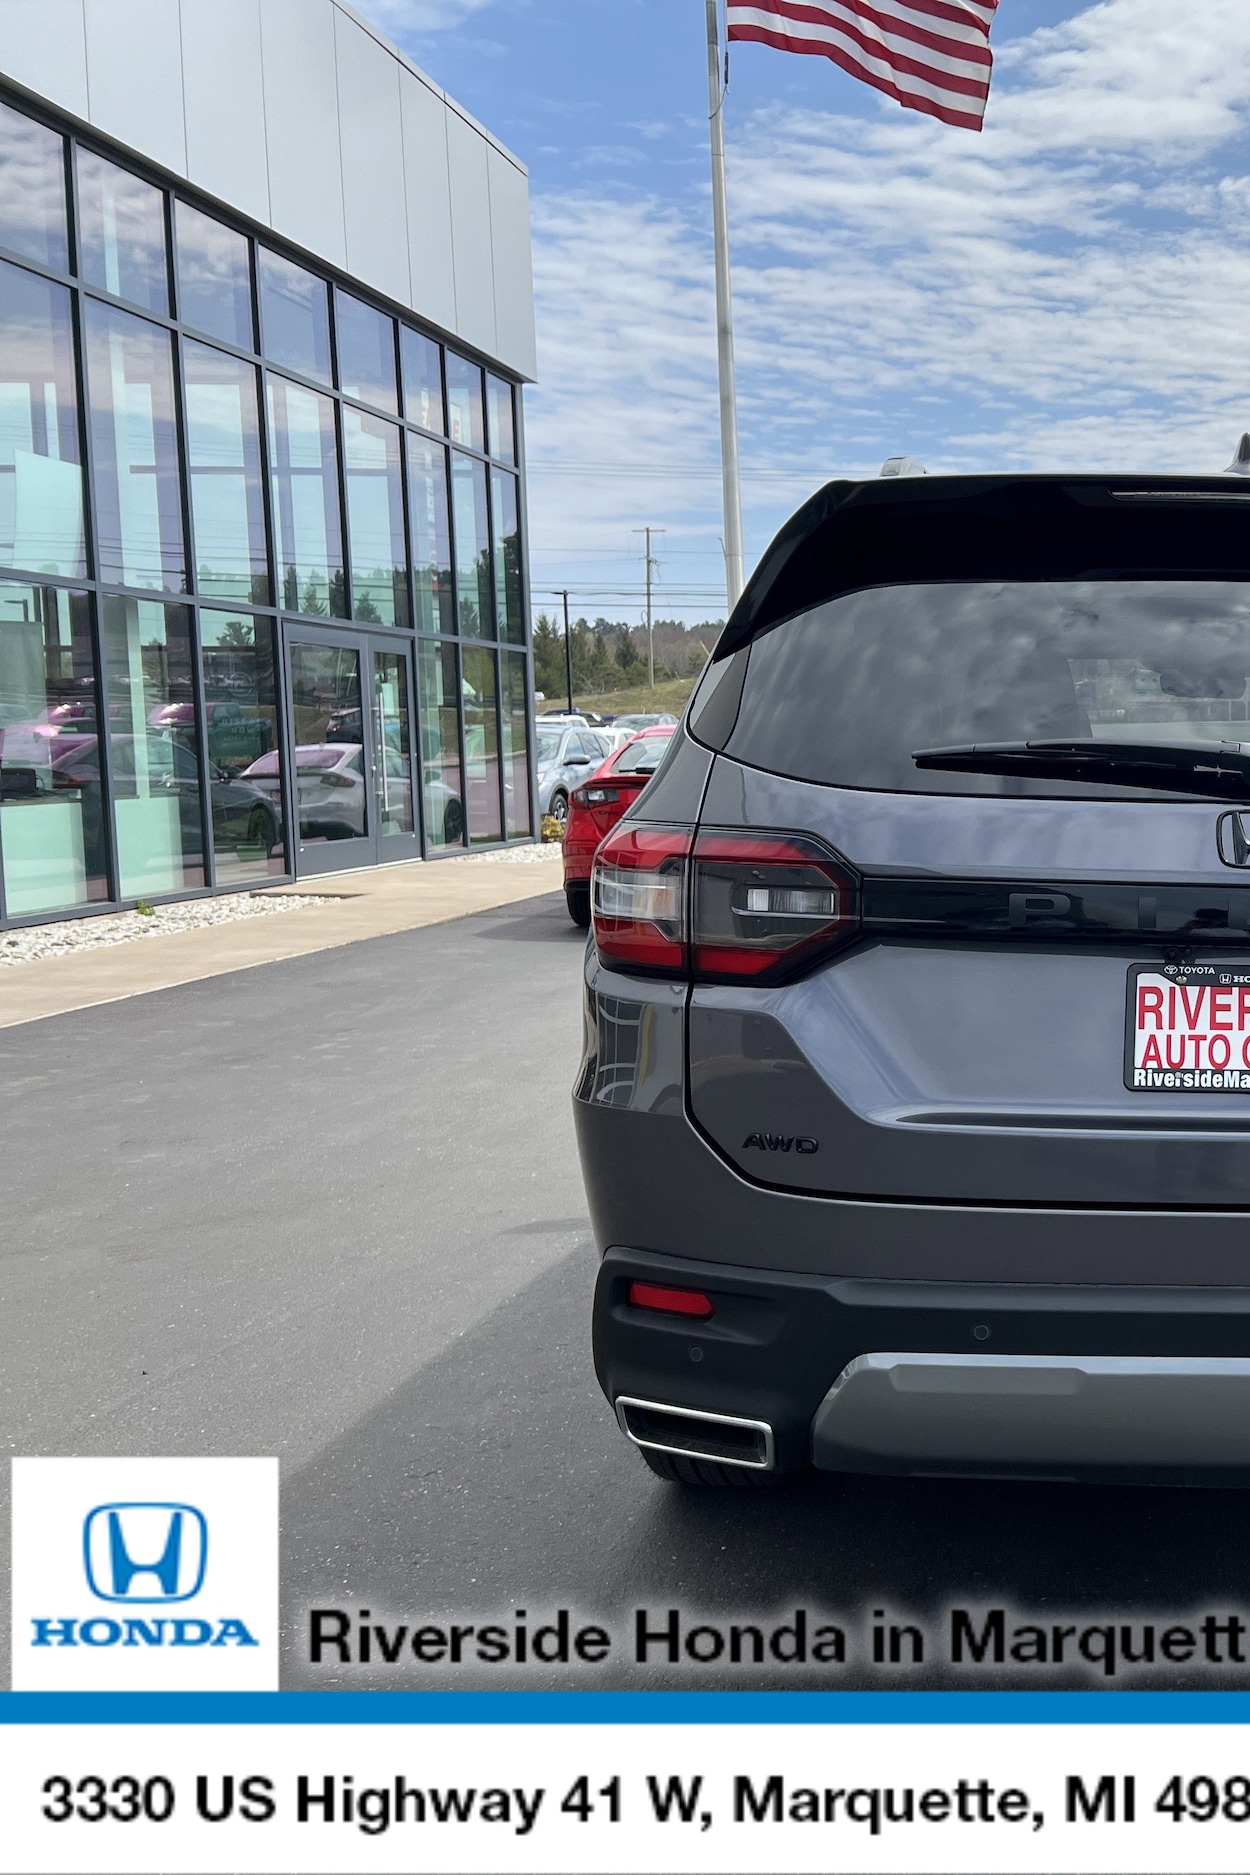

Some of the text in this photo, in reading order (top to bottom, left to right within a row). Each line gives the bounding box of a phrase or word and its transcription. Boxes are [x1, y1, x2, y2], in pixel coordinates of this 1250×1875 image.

[1179, 966, 1216, 975] TOYOTA
[1141, 1034, 1231, 1070] AUTO
[741, 1132, 819, 1154] AWD
